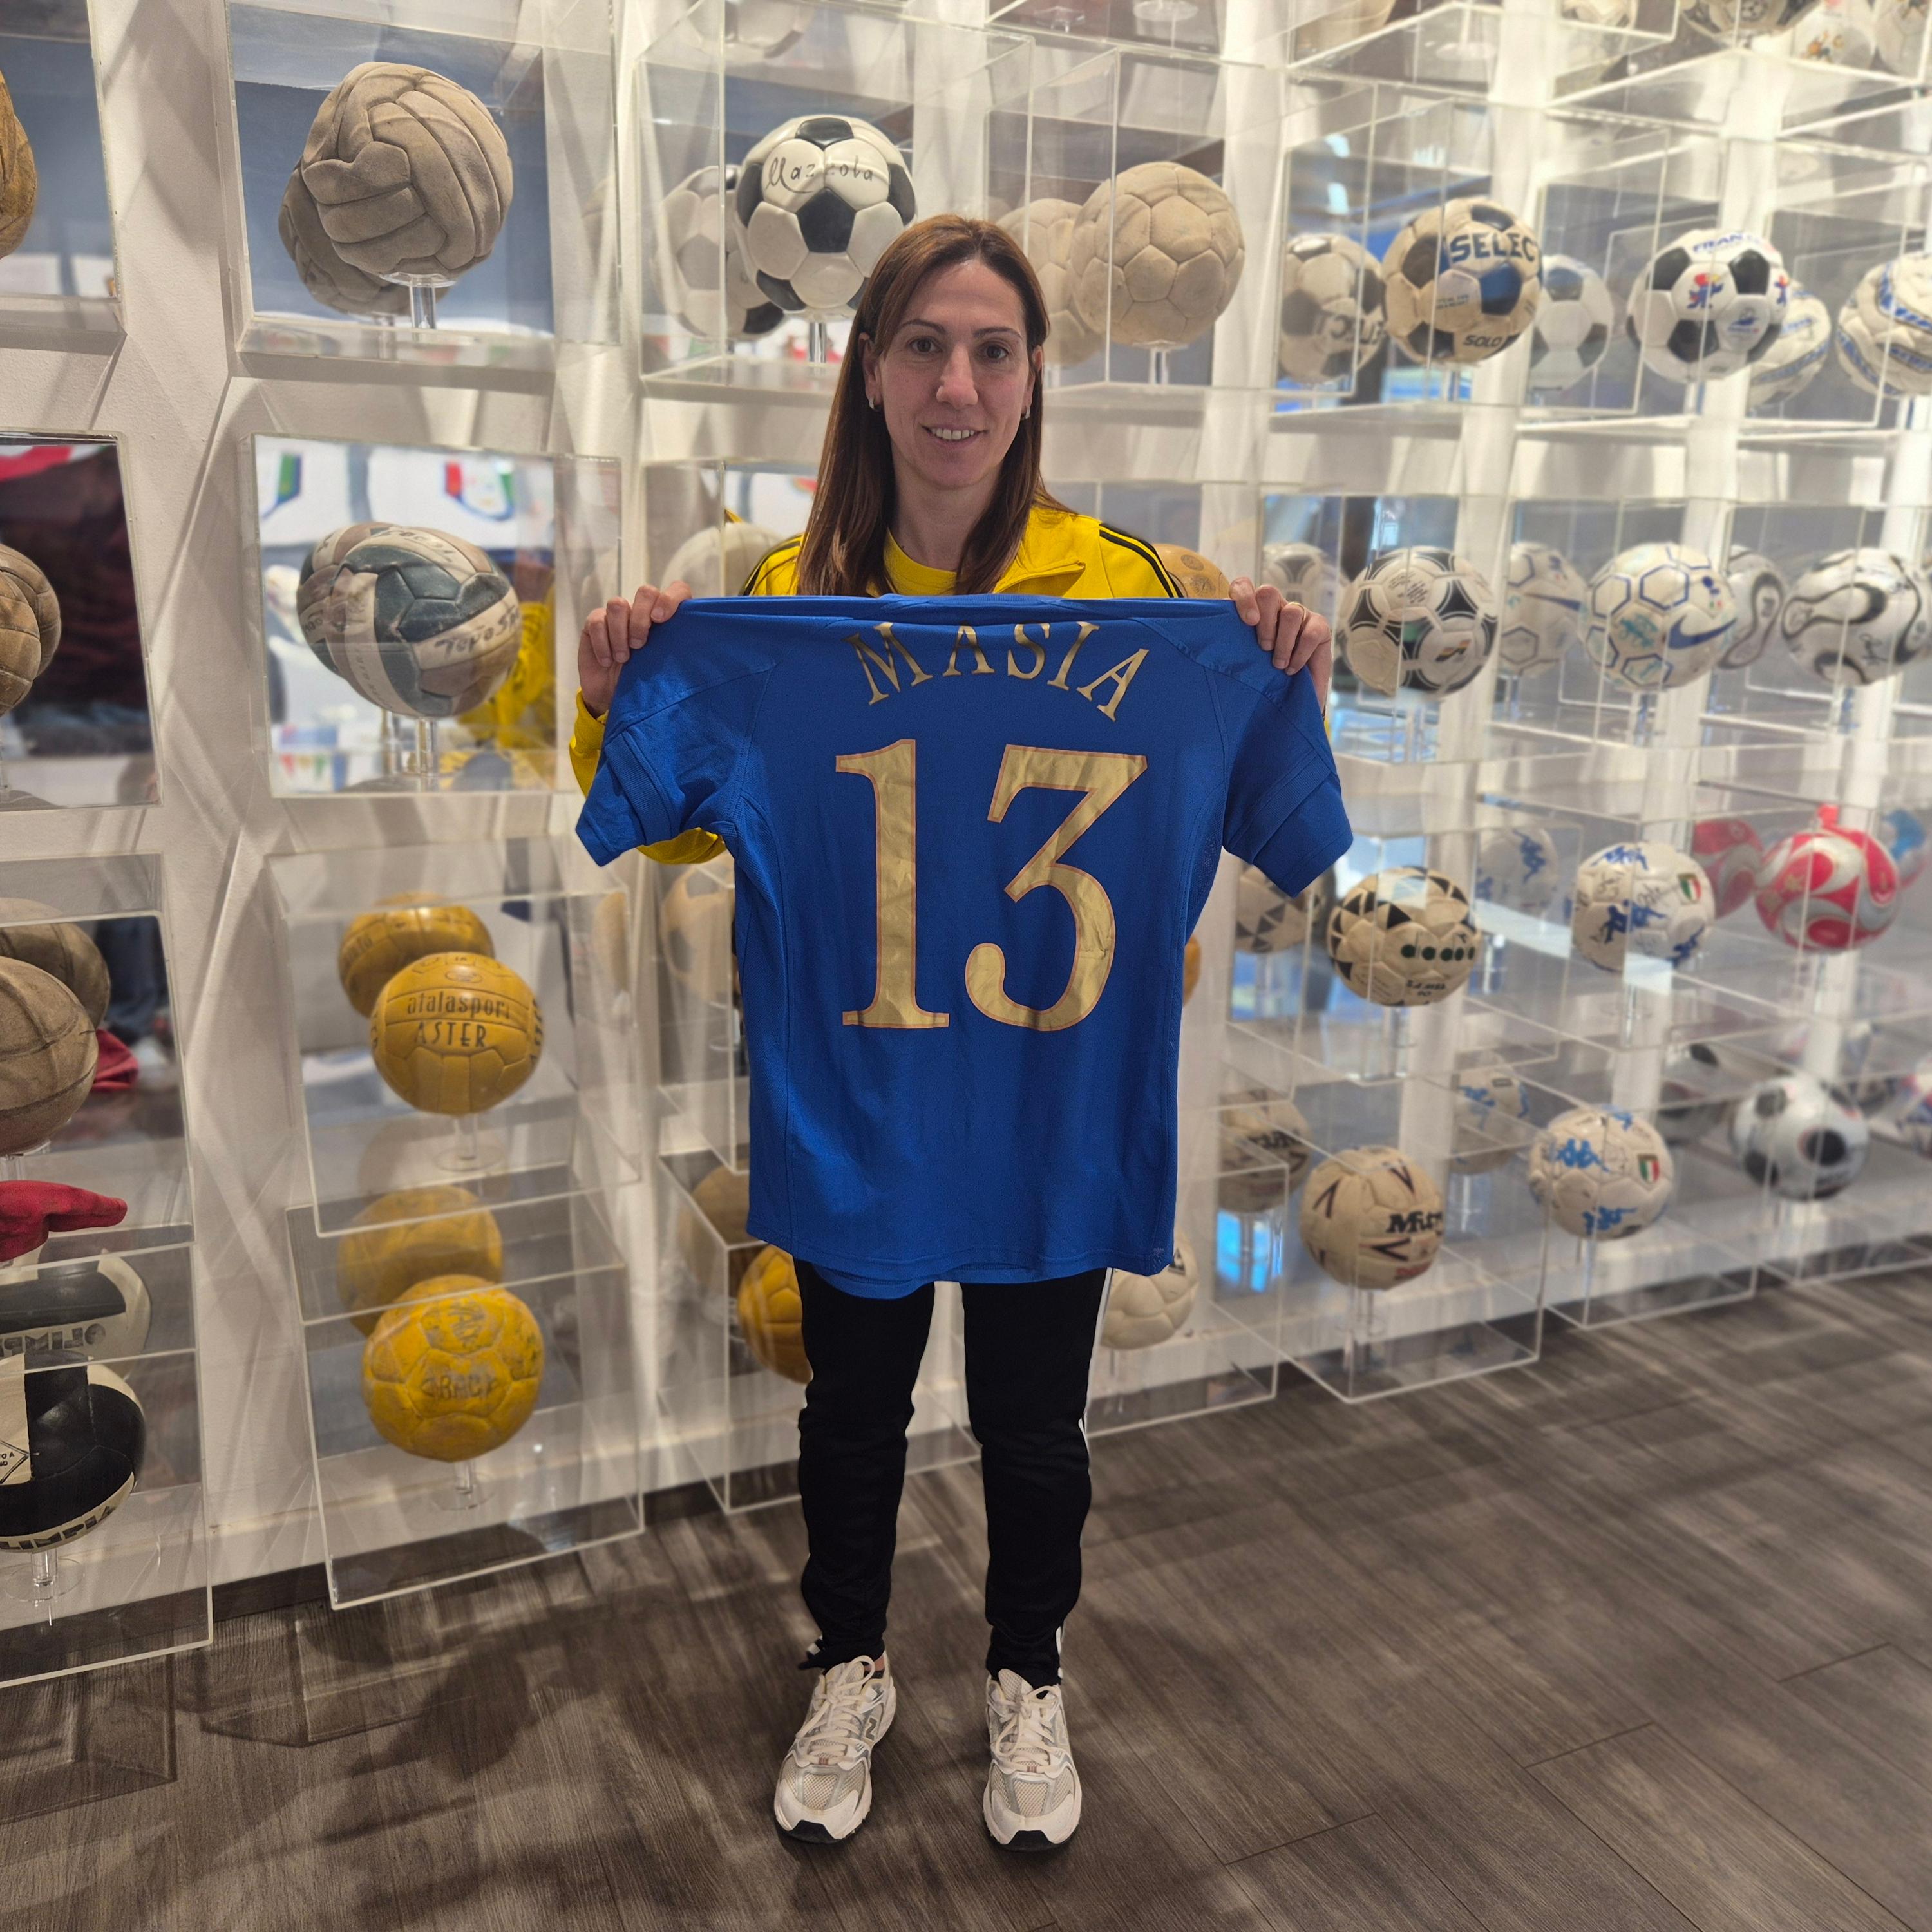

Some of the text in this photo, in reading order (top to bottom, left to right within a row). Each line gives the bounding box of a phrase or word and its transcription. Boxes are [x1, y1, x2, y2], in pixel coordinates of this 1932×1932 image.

[843, 621, 1150, 722] MASIA
[835, 739, 1148, 1032] 13
[414, 1021, 487, 1047] ASTER
